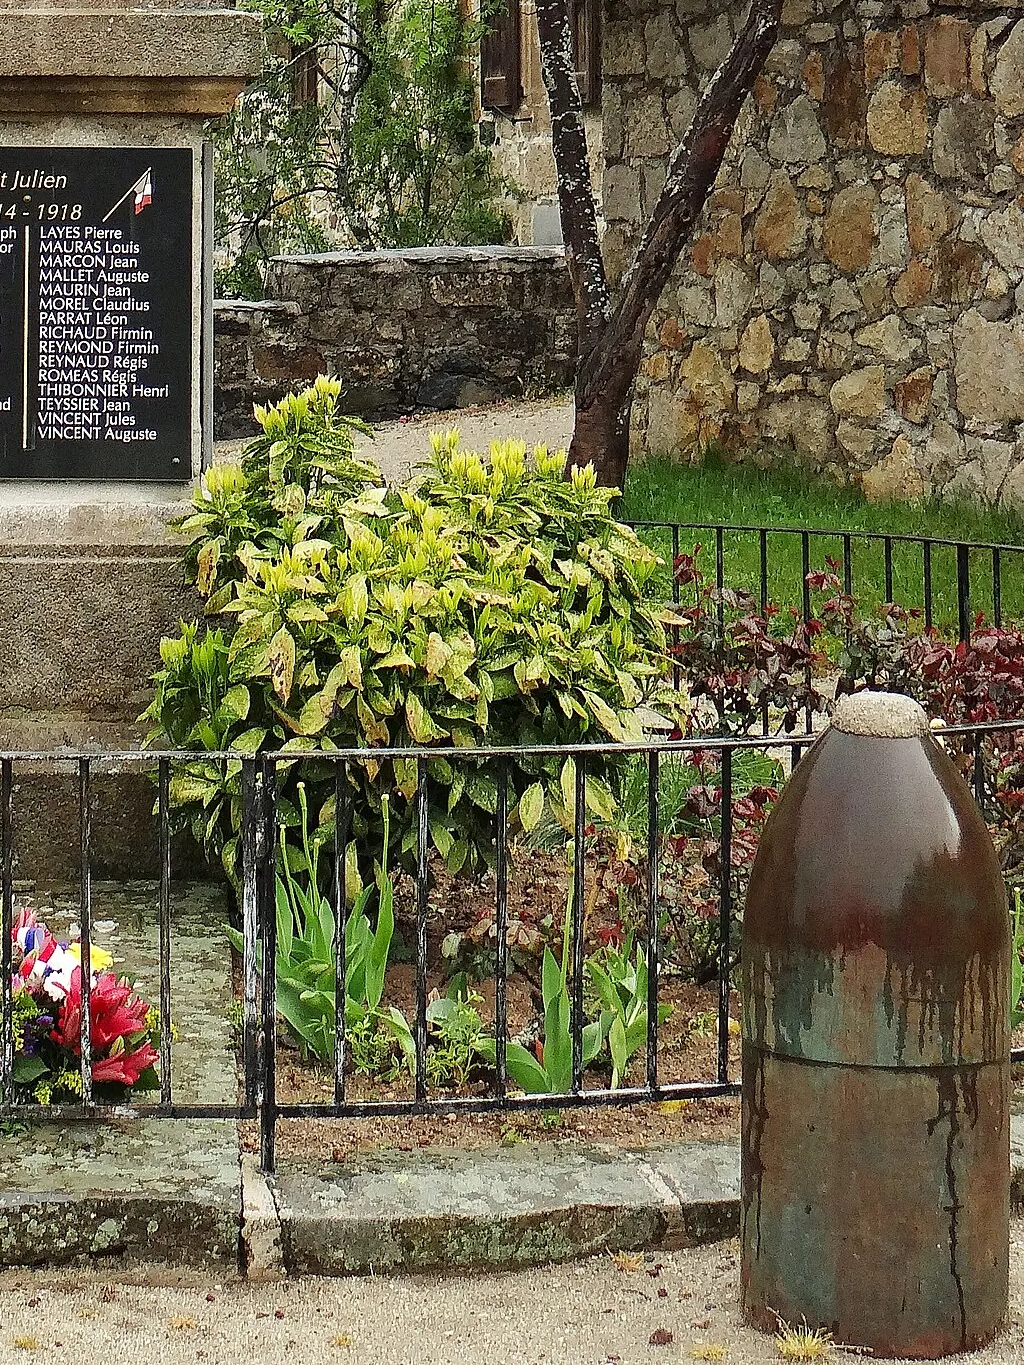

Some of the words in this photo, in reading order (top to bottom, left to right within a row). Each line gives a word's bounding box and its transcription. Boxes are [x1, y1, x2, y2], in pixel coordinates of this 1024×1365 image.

[10, 171, 67, 190] Julien
[37, 205, 83, 220] 1918
[40, 227, 80, 238] LAYES
[85, 227, 122, 239] Pierre
[40, 241, 101, 253] MAURAS
[106, 241, 140, 254] Louis
[39, 255, 105, 267] MARCON
[110, 256, 137, 269] Jean
[39, 269, 93, 281] MALLET
[97, 271, 149, 284] Auguste
[39, 284, 98, 296] MAURIN
[103, 284, 130, 297] Jean
[39, 298, 89, 310] MOREL
[93, 298, 150, 311] Claudius
[40, 312, 92, 325] PARRAT
[96, 313, 128, 325] Léon
[39, 327, 106, 339] RICHAUD
[112, 327, 152, 339] Firmin
[39, 341, 113, 353] REYMOND
[118, 342, 159, 354] Firmin
[39, 355, 109, 368] REYNAUD
[114, 356, 147, 370] Régis
[39, 370, 98, 382] ROMEAS
[102, 370, 137, 384] Régis
[38, 384, 128, 396] THIBONNIER
[133, 385, 169, 397] Henri
[38, 398, 99, 410] TEYSSIER
[102, 399, 130, 412] Jean
[38, 413, 101, 425] VINCENT
[105, 413, 135, 427] Jules
[38, 427, 101, 439] VINCENT
[105, 428, 157, 442] Auguste
